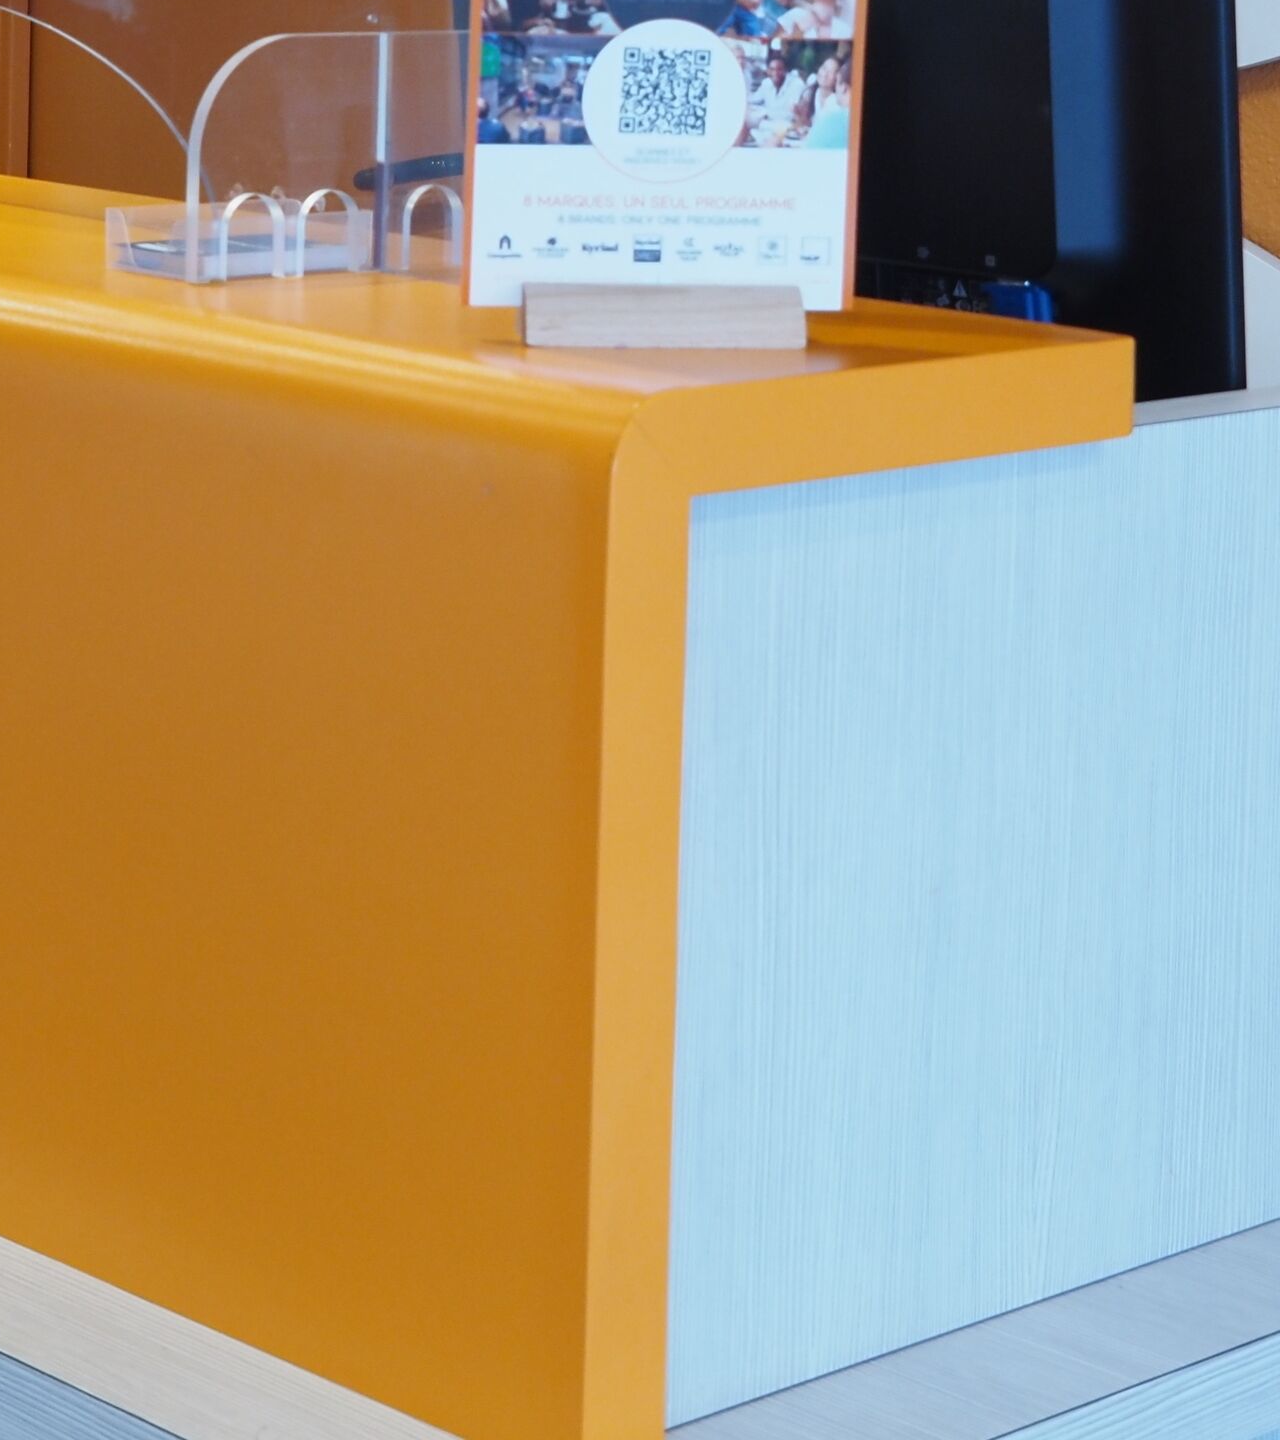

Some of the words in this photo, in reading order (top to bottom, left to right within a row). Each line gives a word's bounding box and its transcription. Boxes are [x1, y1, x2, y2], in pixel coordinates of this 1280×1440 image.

[522, 195, 534, 208] 8
[623, 195, 646, 208] UN
[650, 195, 690, 209] SEUL
[696, 196, 796, 210] PROGRAMME
